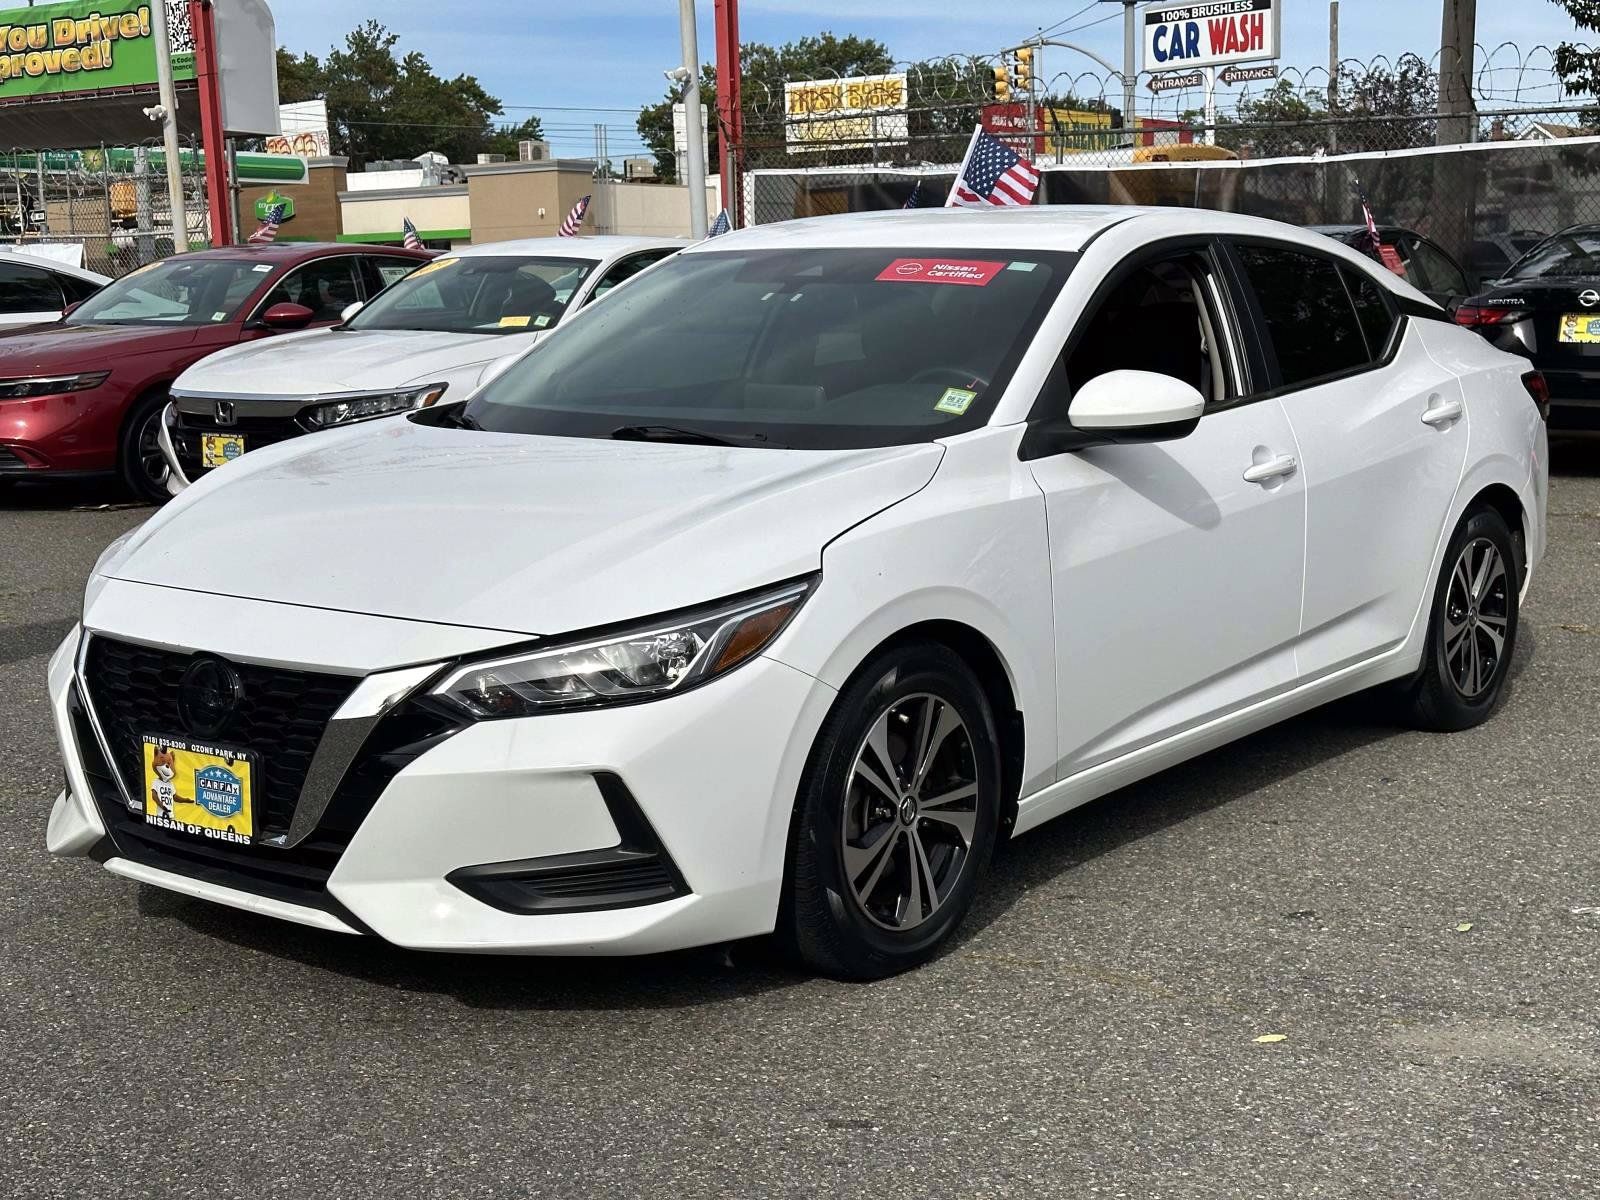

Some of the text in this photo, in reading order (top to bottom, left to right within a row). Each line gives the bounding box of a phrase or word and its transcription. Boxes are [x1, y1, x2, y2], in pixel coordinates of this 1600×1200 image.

[1160, 1, 1253, 22] 100% BRUSHLESS
[53, 6, 150, 46] Drive!
[1153, 13, 1263, 62] CAR WASH
[1225, 68, 1273, 81] ENTRANCE
[1152, 76, 1198, 89] ENTRANCE
[933, 263, 977, 272] Nissan
[927, 270, 985, 279] Certified
[143, 735, 157, 744] (718)
[191, 744, 214, 755] OZONE
[215, 748, 235, 759] PARK,
[237, 752, 247, 760] NY
[160, 786, 171, 796] CAR
[200, 779, 238, 794] CARFAX
[160, 796, 173, 806] FOX
[203, 791, 237, 805] ADVANTAGE
[208, 801, 231, 813] DEALER
[145, 814, 250, 845] NISSAN OF QUEENS
